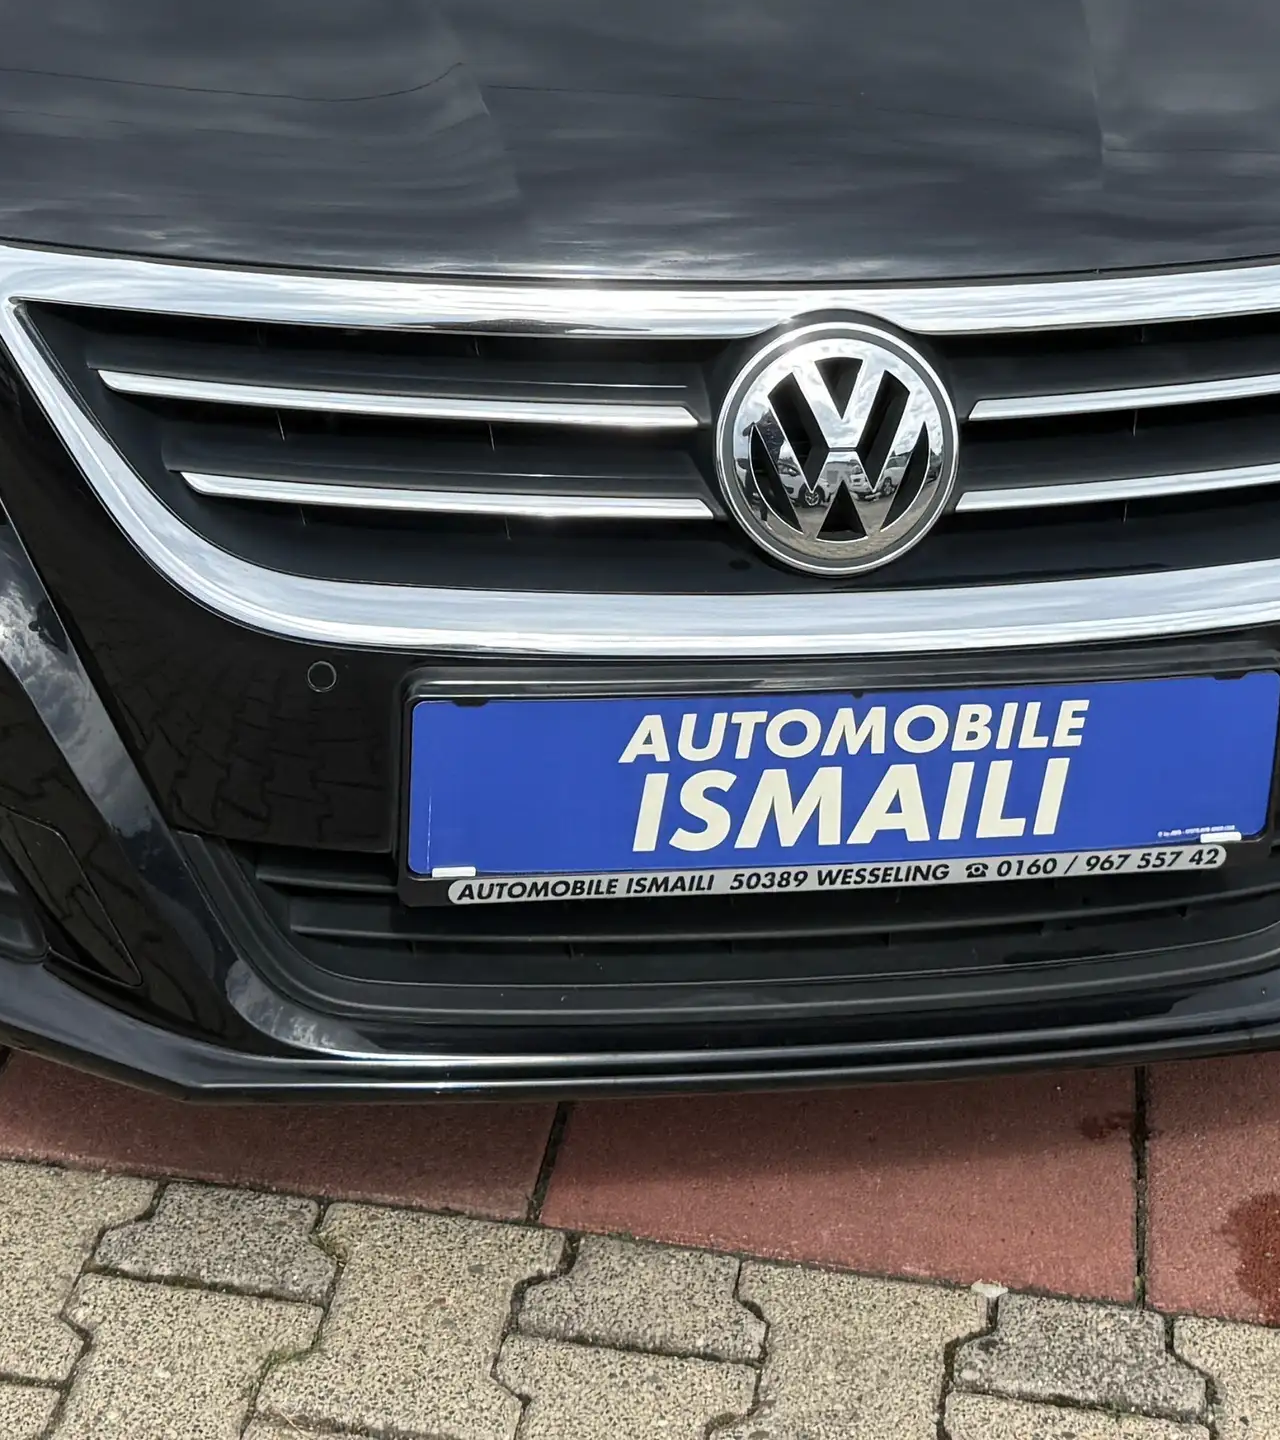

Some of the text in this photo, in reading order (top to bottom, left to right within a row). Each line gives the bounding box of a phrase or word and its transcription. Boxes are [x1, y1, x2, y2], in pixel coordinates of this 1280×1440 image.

[727, 332, 950, 566] VW
[618, 698, 1091, 764] AUTOMOBILE
[630, 756, 1072, 854] ISMAILI
[456, 847, 1220, 902] AUTOMOBILE ISMAILI 50389 WESSELING 0160 / 967 557 42
